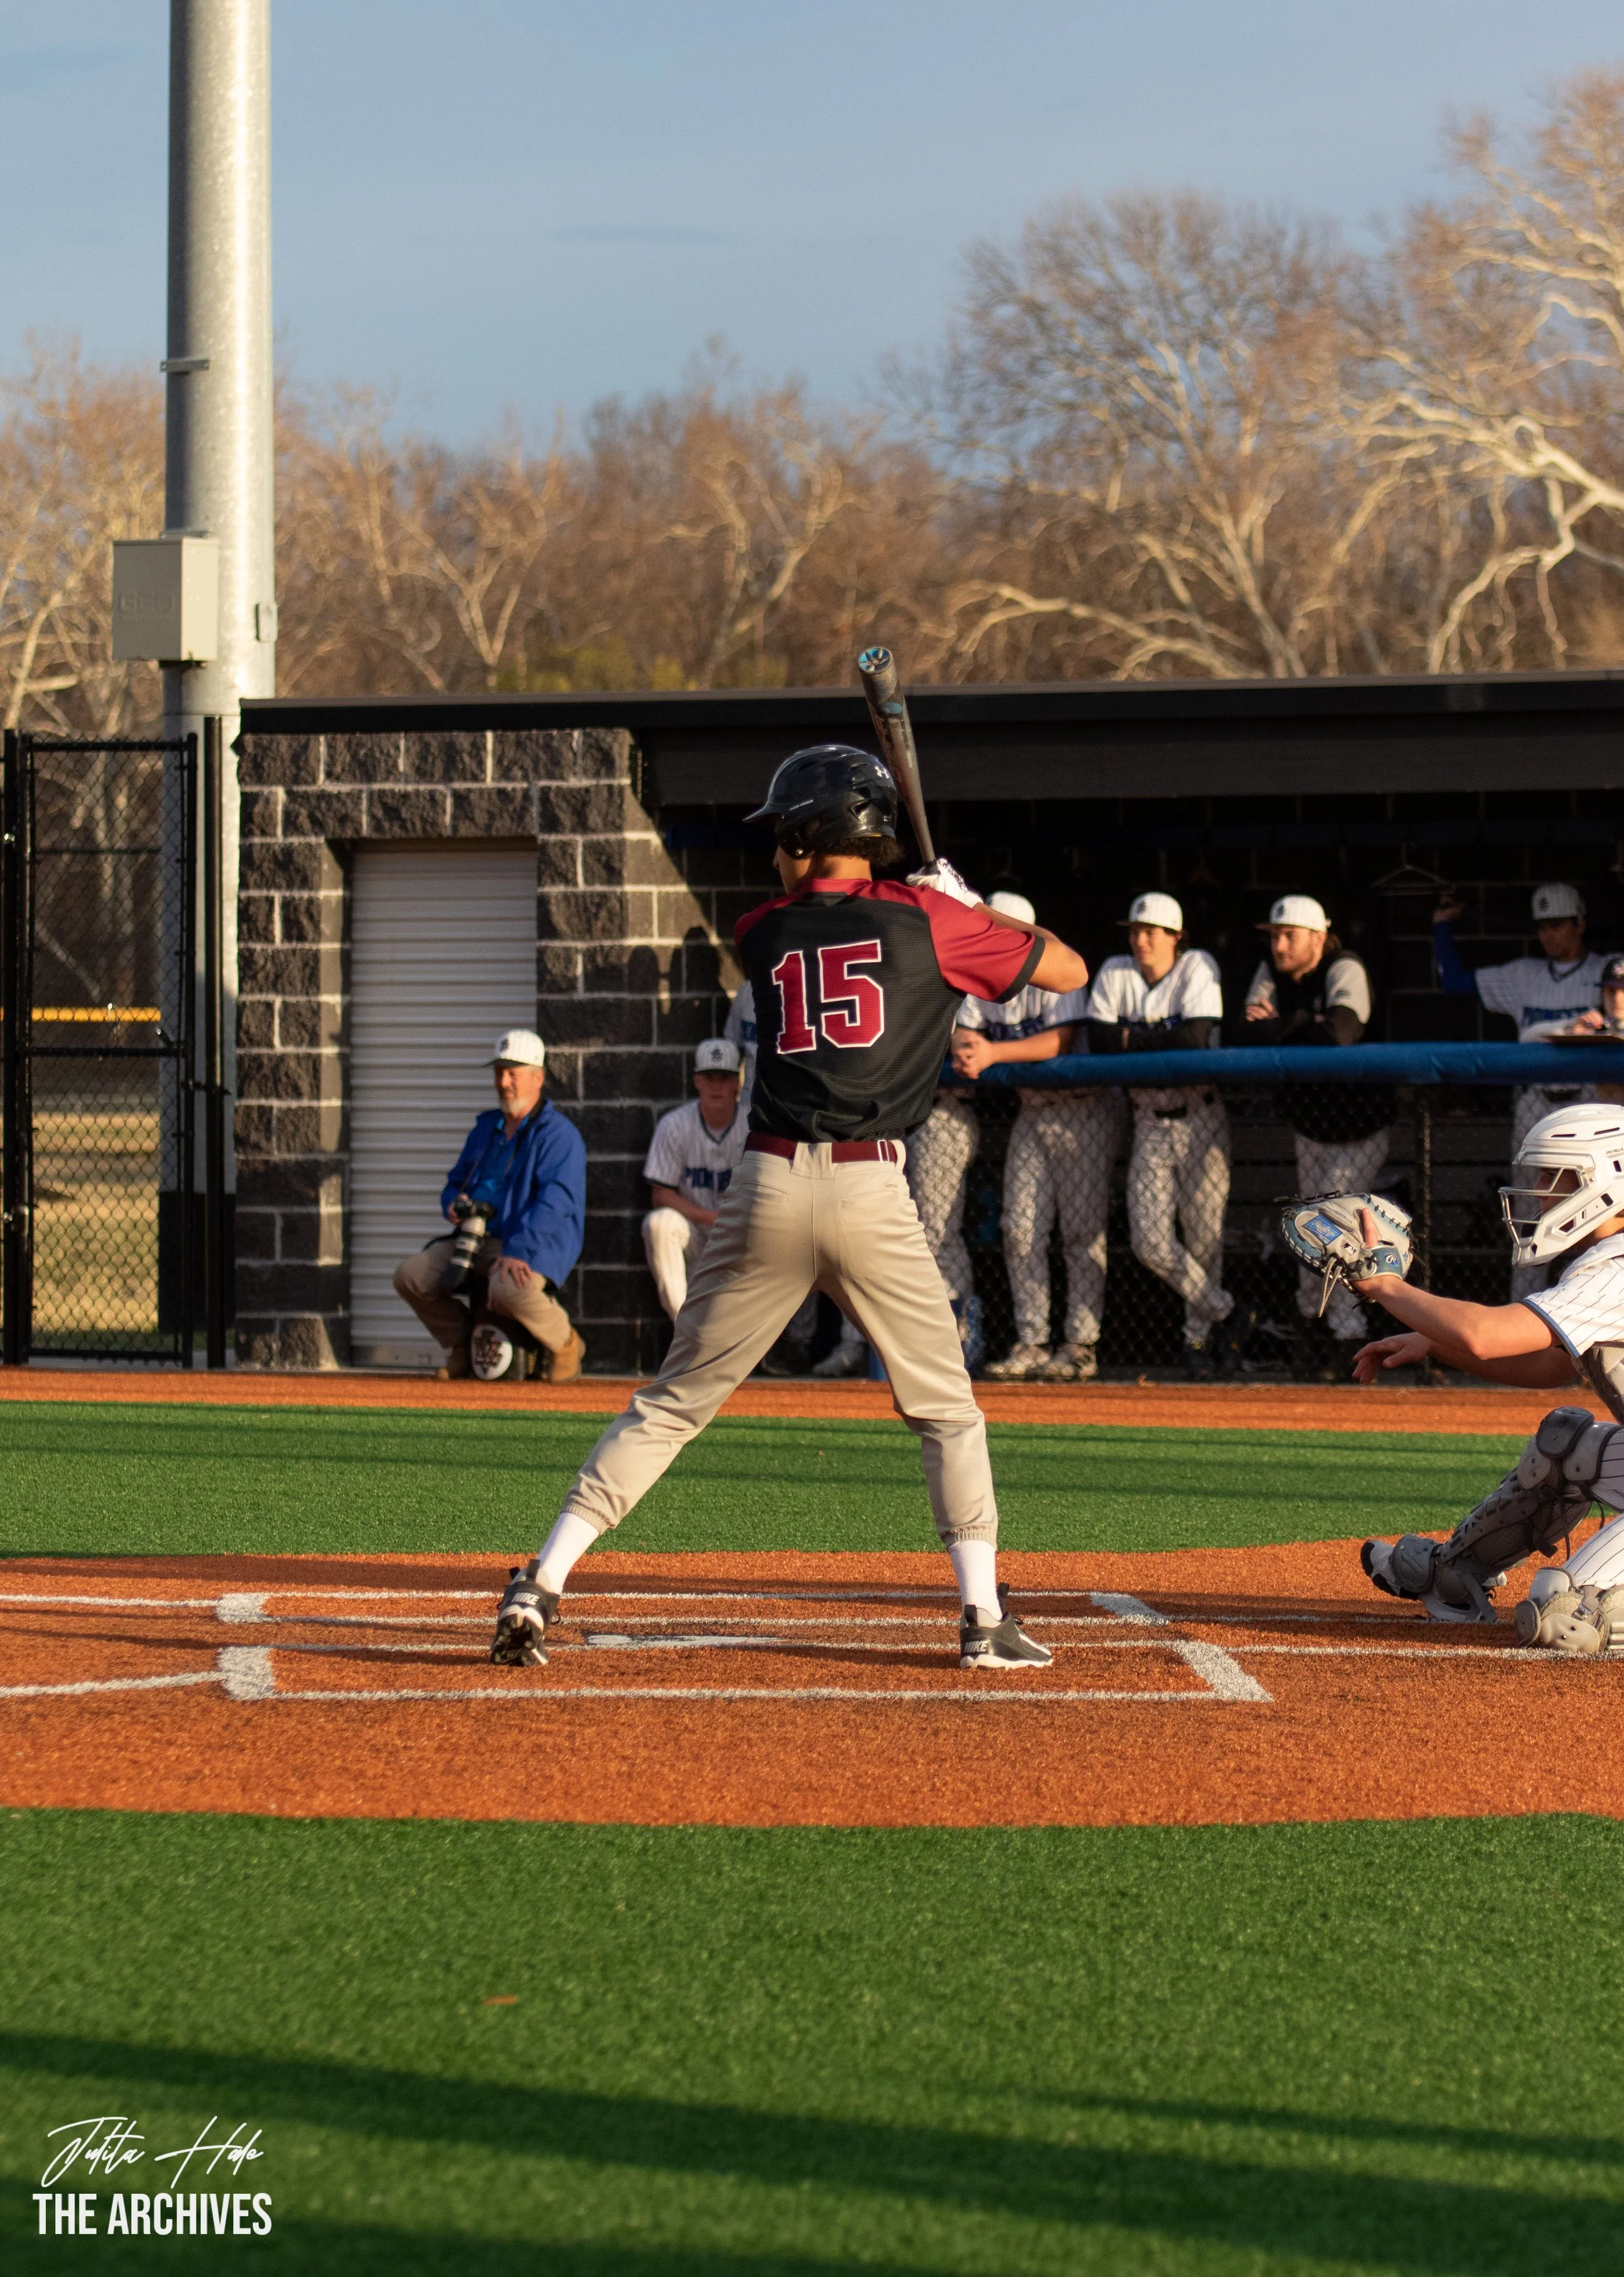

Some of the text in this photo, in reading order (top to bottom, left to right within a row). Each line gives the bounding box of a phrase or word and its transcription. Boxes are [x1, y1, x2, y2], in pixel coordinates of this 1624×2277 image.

[771, 939, 884, 1054] 15
[511, 1592, 540, 1605] NIKE
[964, 1640, 988, 1653] NIKE
